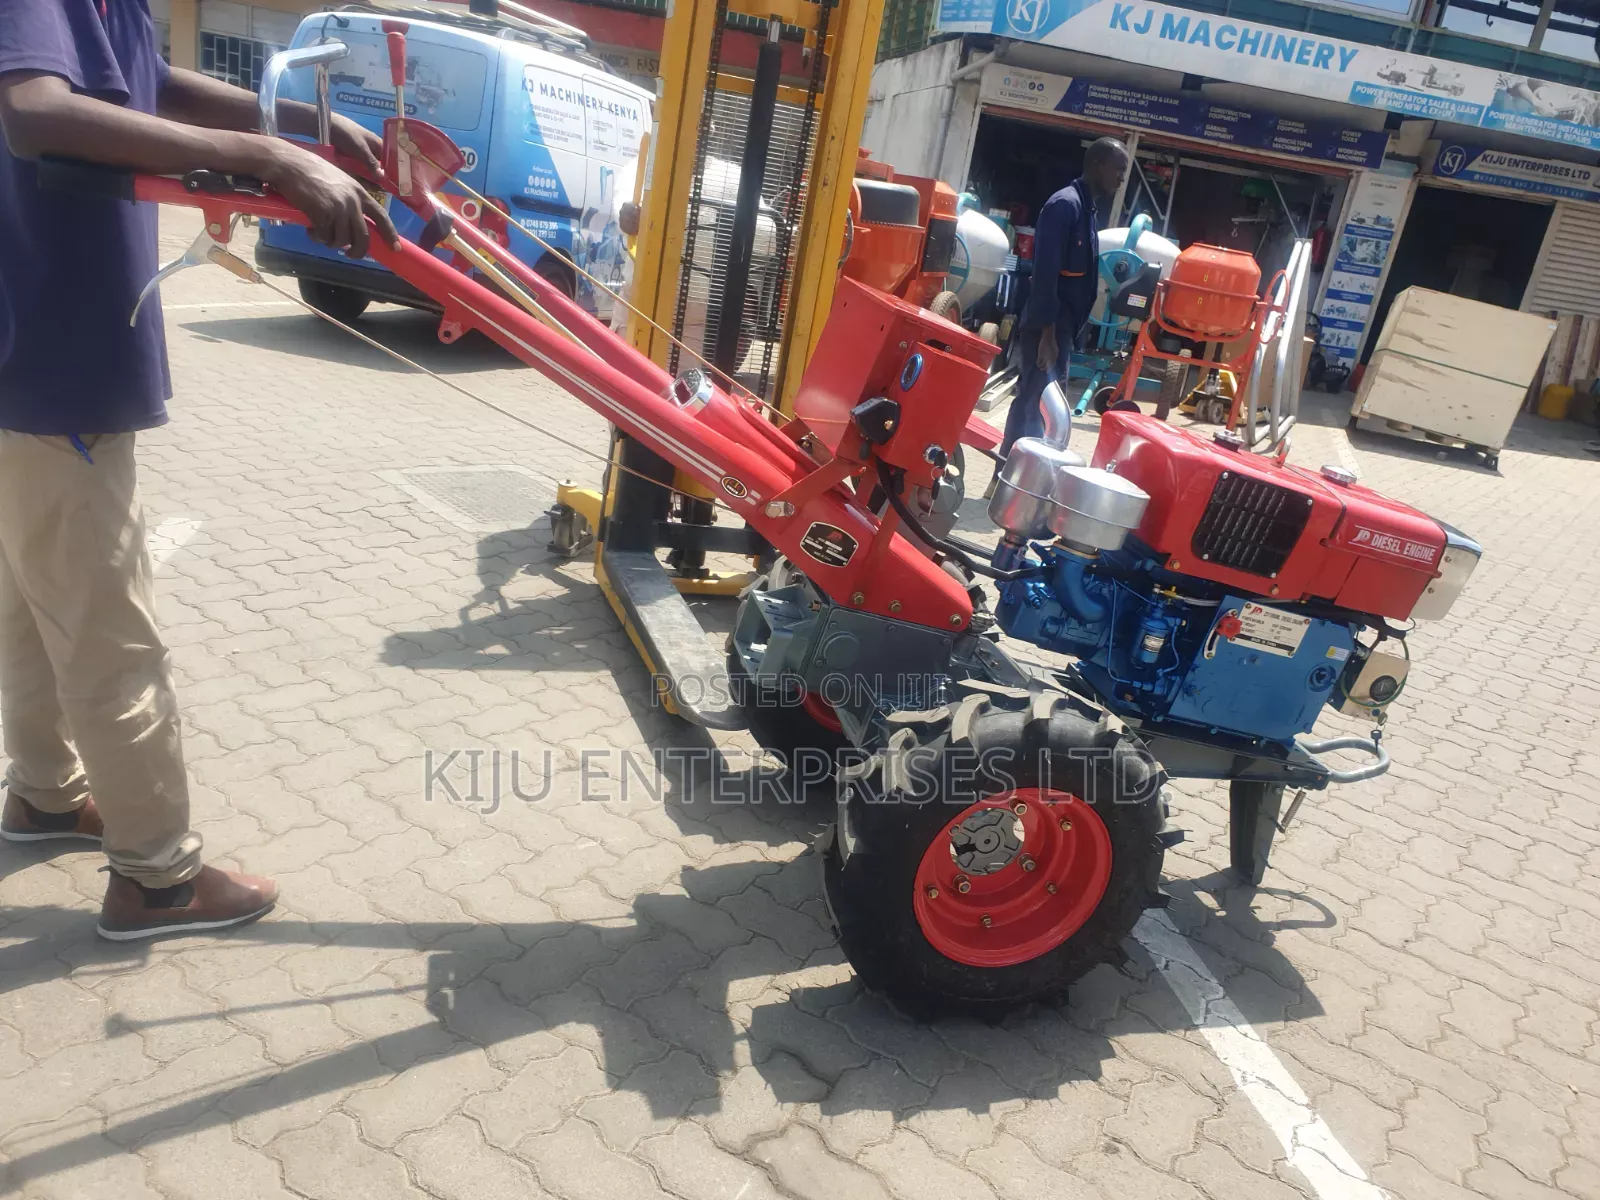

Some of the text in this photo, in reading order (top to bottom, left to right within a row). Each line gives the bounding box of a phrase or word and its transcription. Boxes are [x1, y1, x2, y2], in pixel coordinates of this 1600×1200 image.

[1109, 3, 1360, 73] KJ MACHINERY
[521, 78, 534, 93] KJ
[539, 82, 603, 112] MACHINERY
[608, 105, 639, 121] KENYA
[1089, 84, 1109, 93] POWER
[1110, 88, 1142, 98] GENERATOR
[1110, 94, 1124, 102] NEW
[1355, 86, 1383, 96] POWER
[1384, 90, 1428, 105] GENERATOR
[1428, 98, 1449, 109] SALES
[1457, 104, 1480, 115] LEASE
[339, 93, 414, 114] POWER GENERARS
[1085, 102, 1106, 111] POWER
[1106, 105, 1137, 117] GENERATOR
[1404, 101, 1421, 112] NEW
[1421, 106, 1428, 114] &
[1488, 110, 1515, 122] POWER
[1515, 115, 1557, 130] GENERATOR
[1504, 121, 1555, 137] MAINTENANCE
[1562, 133, 1591, 145] REPAIRS
[1442, 152, 1463, 174] KJ
[1481, 153, 1507, 166] KIJU
[1507, 157, 1570, 178] ENTERPRISES
[1571, 168, 1591, 181] LTD
[1371, 534, 1400, 553] DIESEL
[1403, 543, 1436, 561] ENGINE
